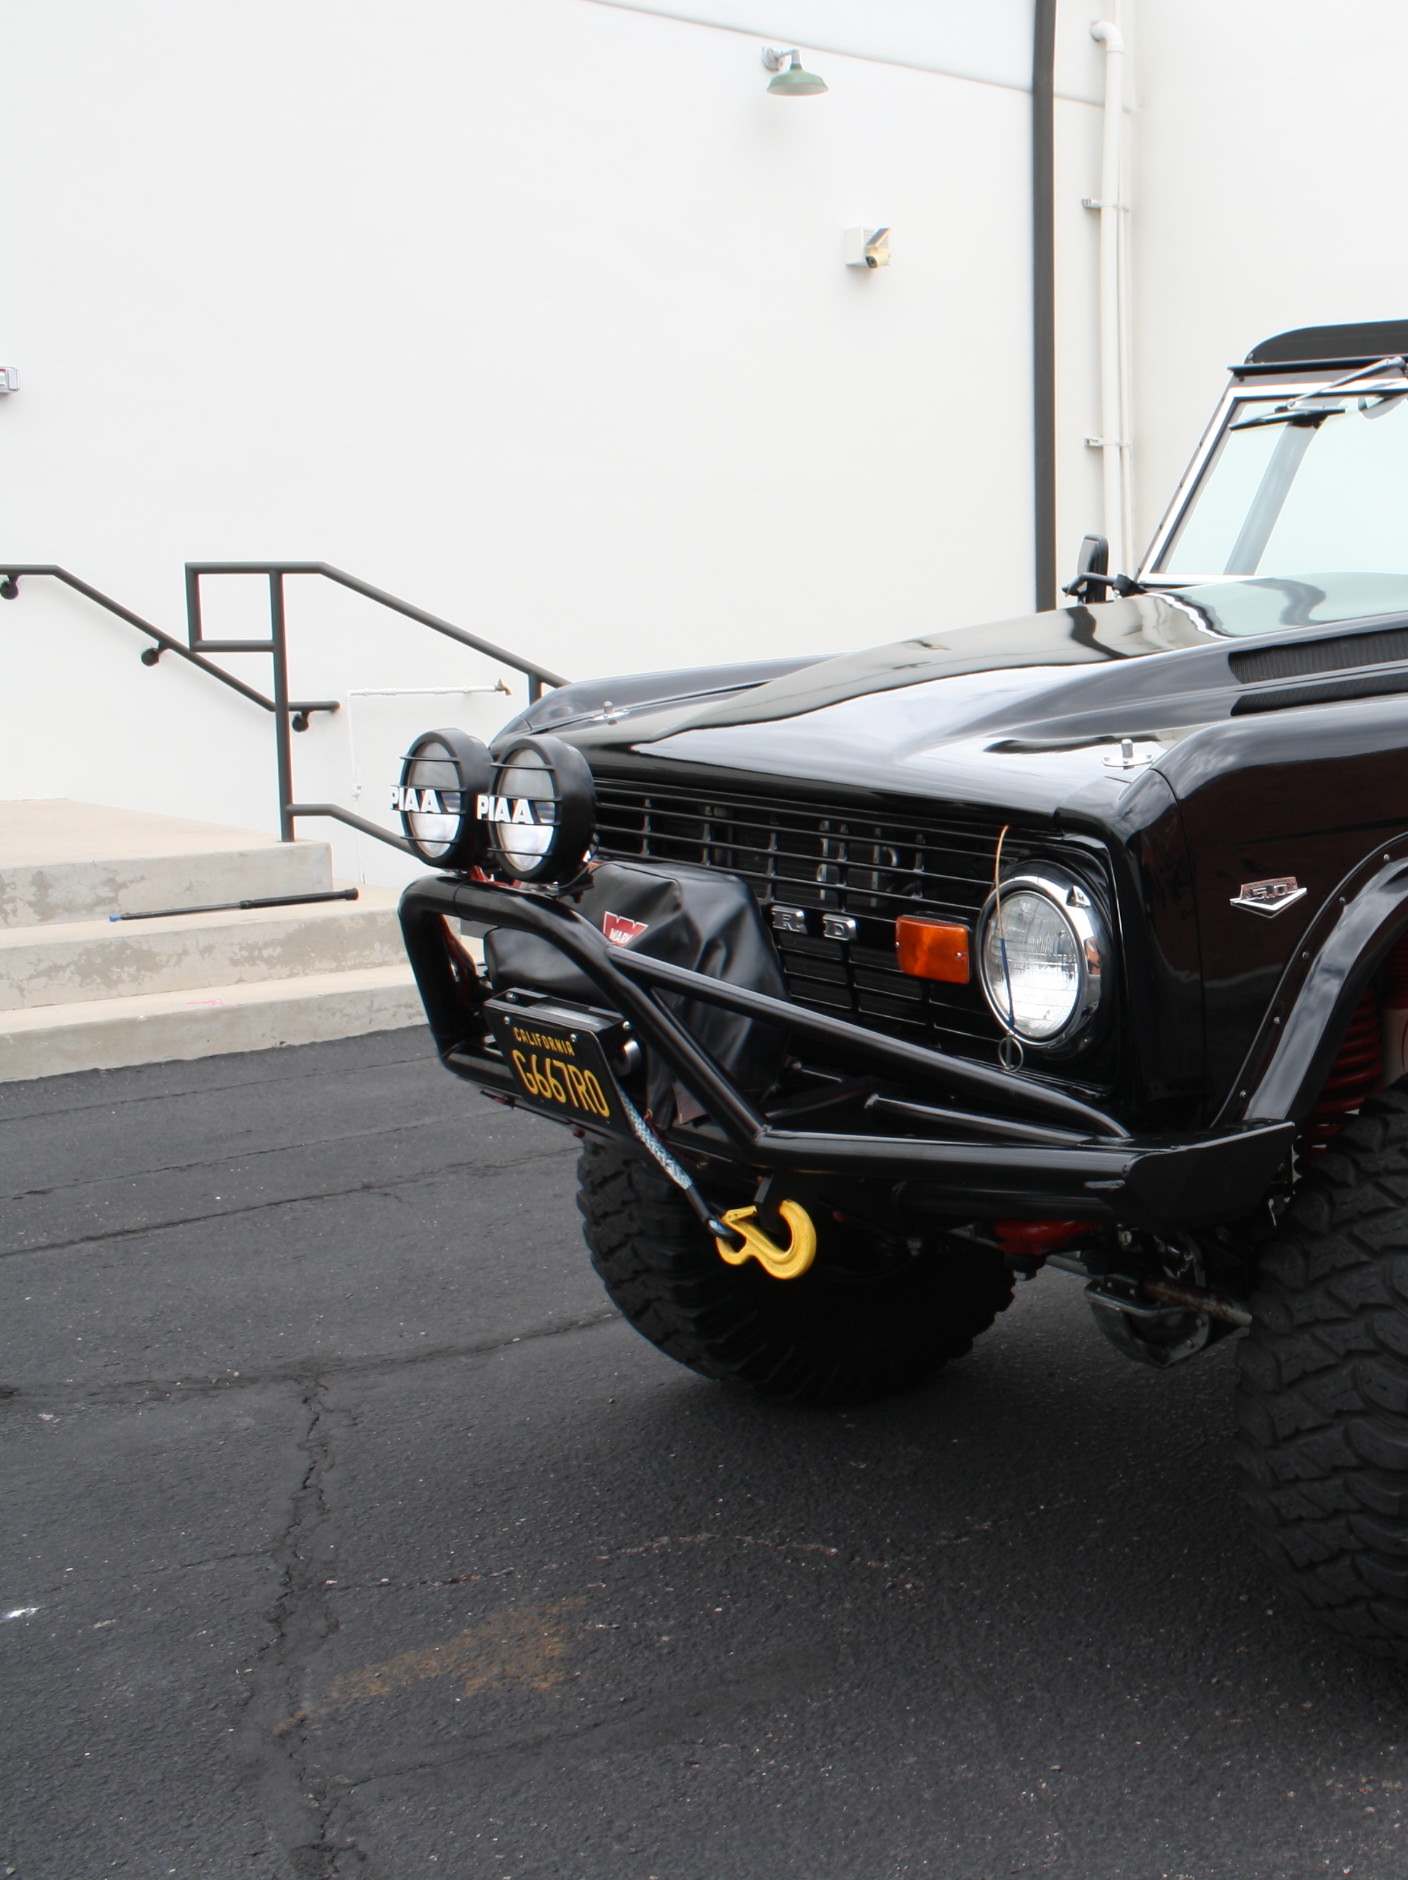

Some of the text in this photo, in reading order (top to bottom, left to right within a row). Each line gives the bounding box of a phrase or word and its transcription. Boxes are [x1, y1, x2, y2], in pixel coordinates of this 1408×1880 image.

[389, 786, 442, 814] PIAA
[476, 794, 535, 825] PIAA
[771, 904, 858, 941] RD
[513, 1027, 575, 1057] CALIFORNIA
